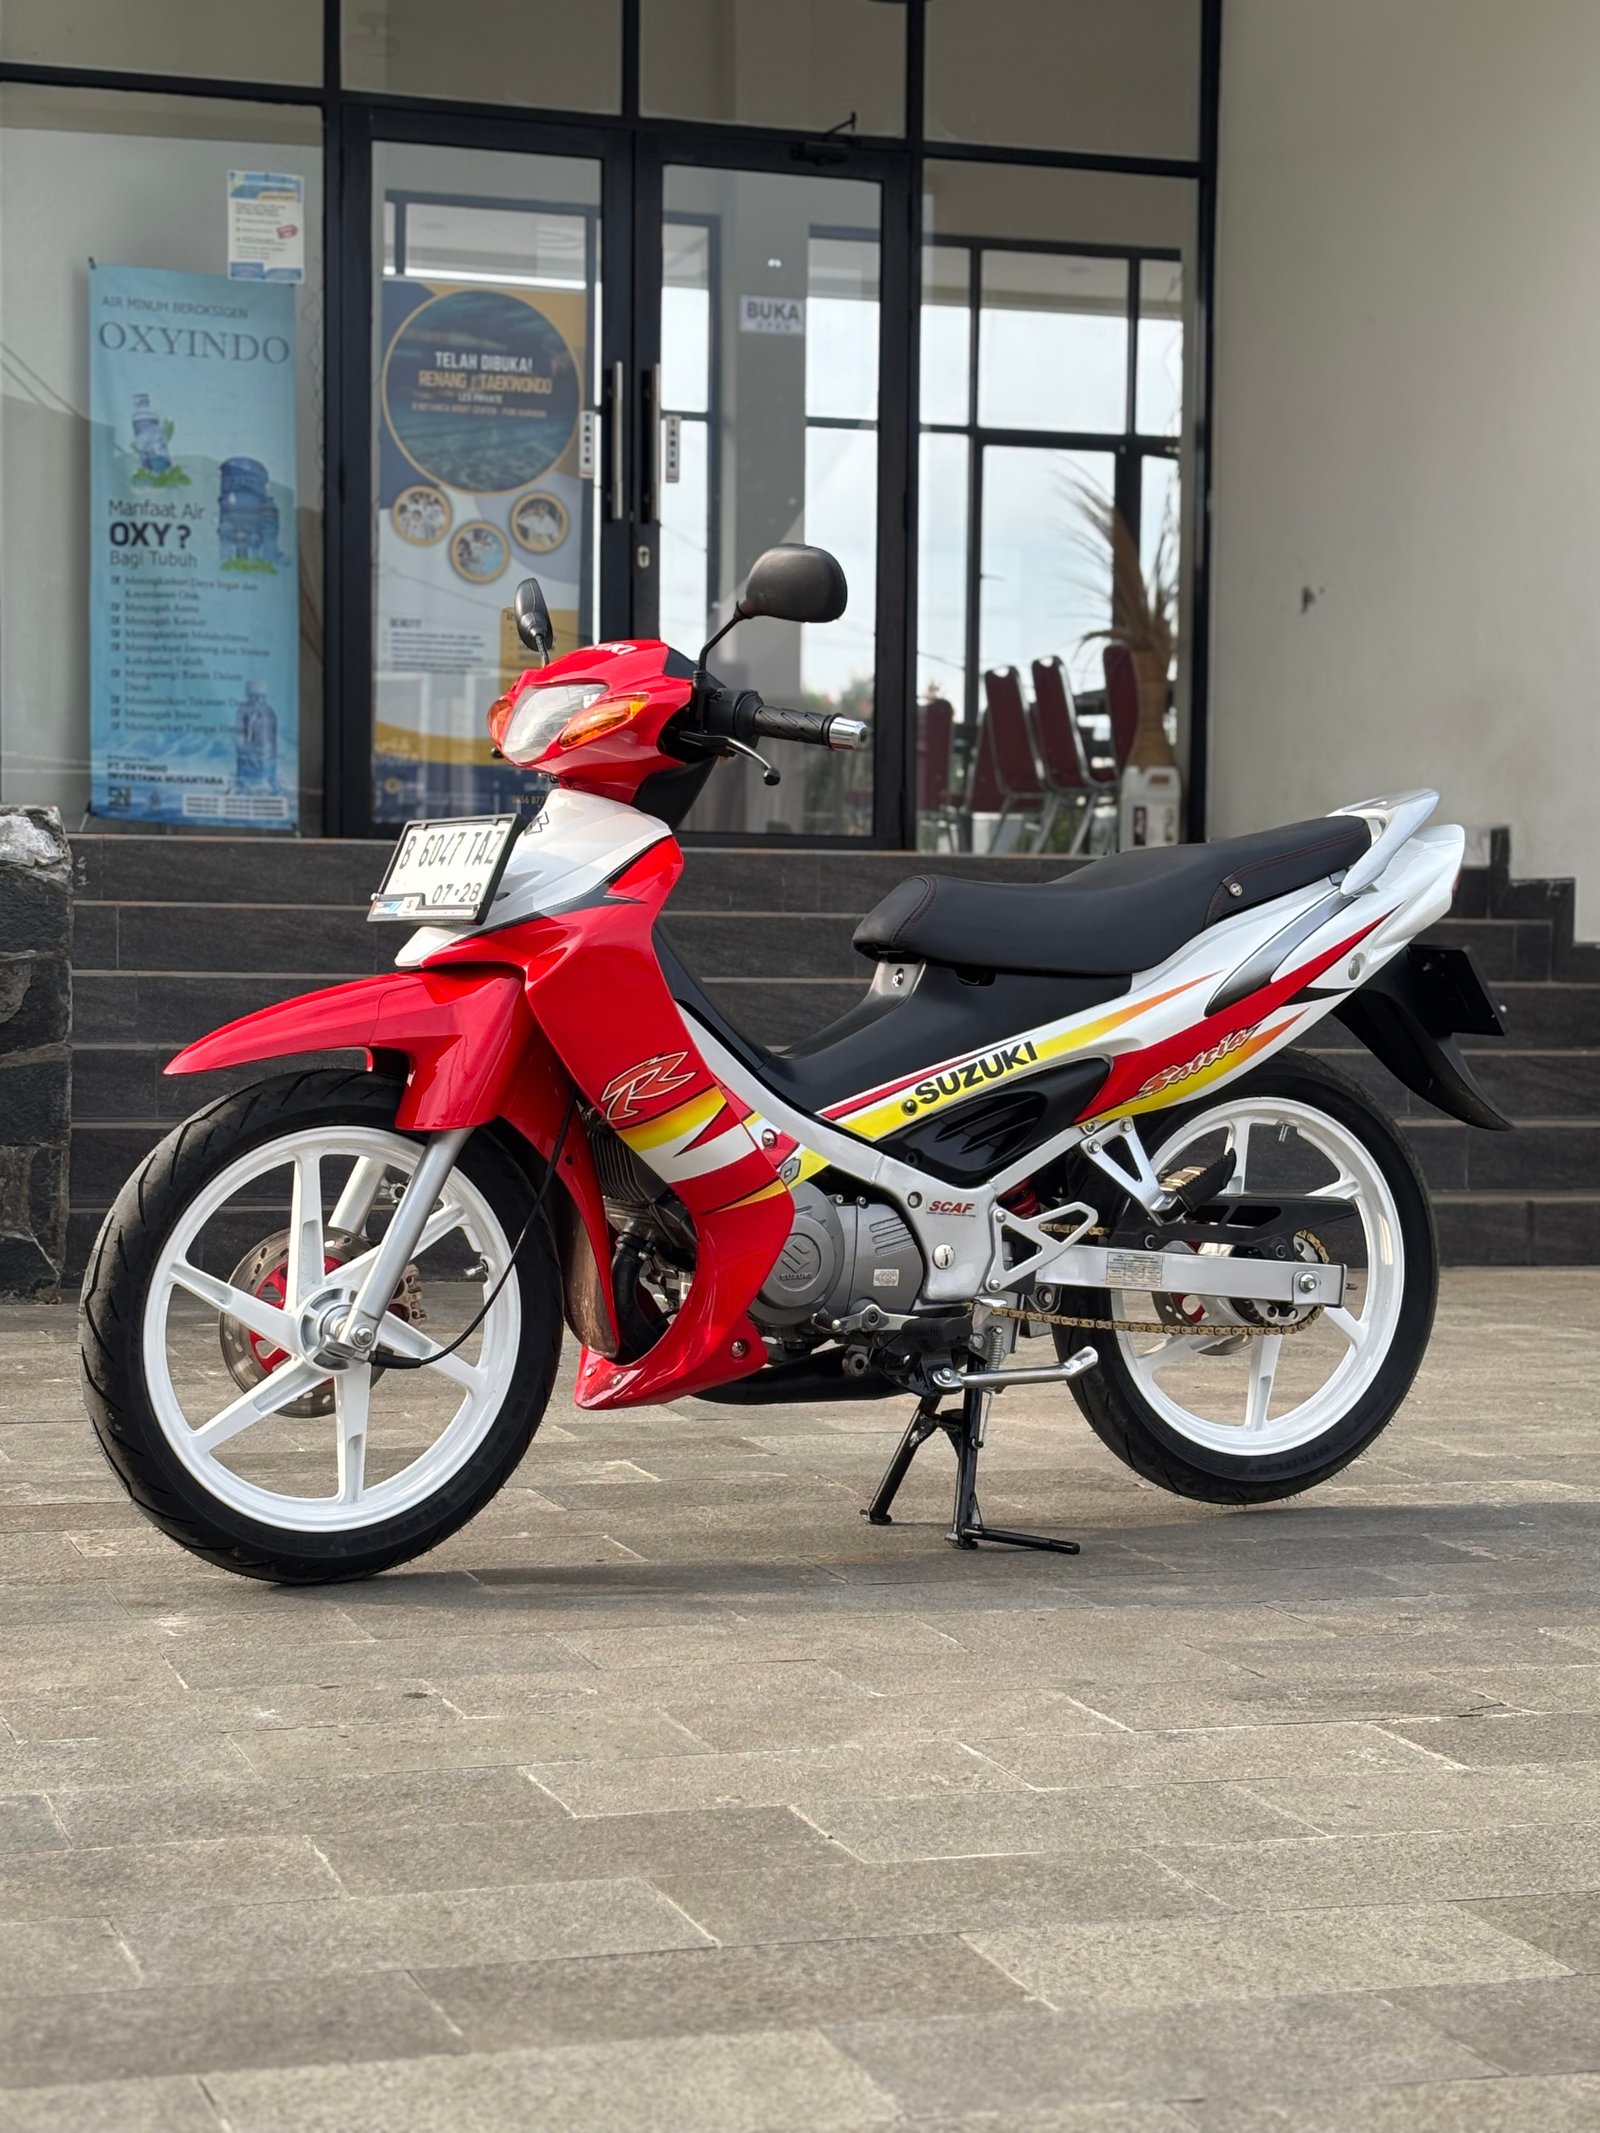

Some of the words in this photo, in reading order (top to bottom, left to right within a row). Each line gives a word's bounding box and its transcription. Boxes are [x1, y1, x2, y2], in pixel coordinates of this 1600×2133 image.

[102, 296, 124, 310] AIR
[127, 298, 169, 314] MINUM
[172, 302, 248, 320] BEROKSIGEN
[747, 301, 799, 322] BUKA
[99, 321, 290, 365] OXYINDO
[434, 350, 478, 370] TELAH
[480, 354, 533, 373] DIBUKA!
[418, 370, 467, 389] RENANG
[479, 374, 553, 395] TAEKWONDO
[108, 500, 177, 519] Manfaat
[181, 503, 206, 520] Air
[110, 549, 144, 570] Bagi
[148, 550, 198, 569] Tubuh
[399, 835, 417, 870] B
[418, 832, 467, 867] 6047
[464, 830, 506, 867] TAZ
[915, 1041, 1038, 1105] SUZUKI
[1136, 1023, 1262, 1100] Satria
[928, 1200, 976, 1214] SCAF
